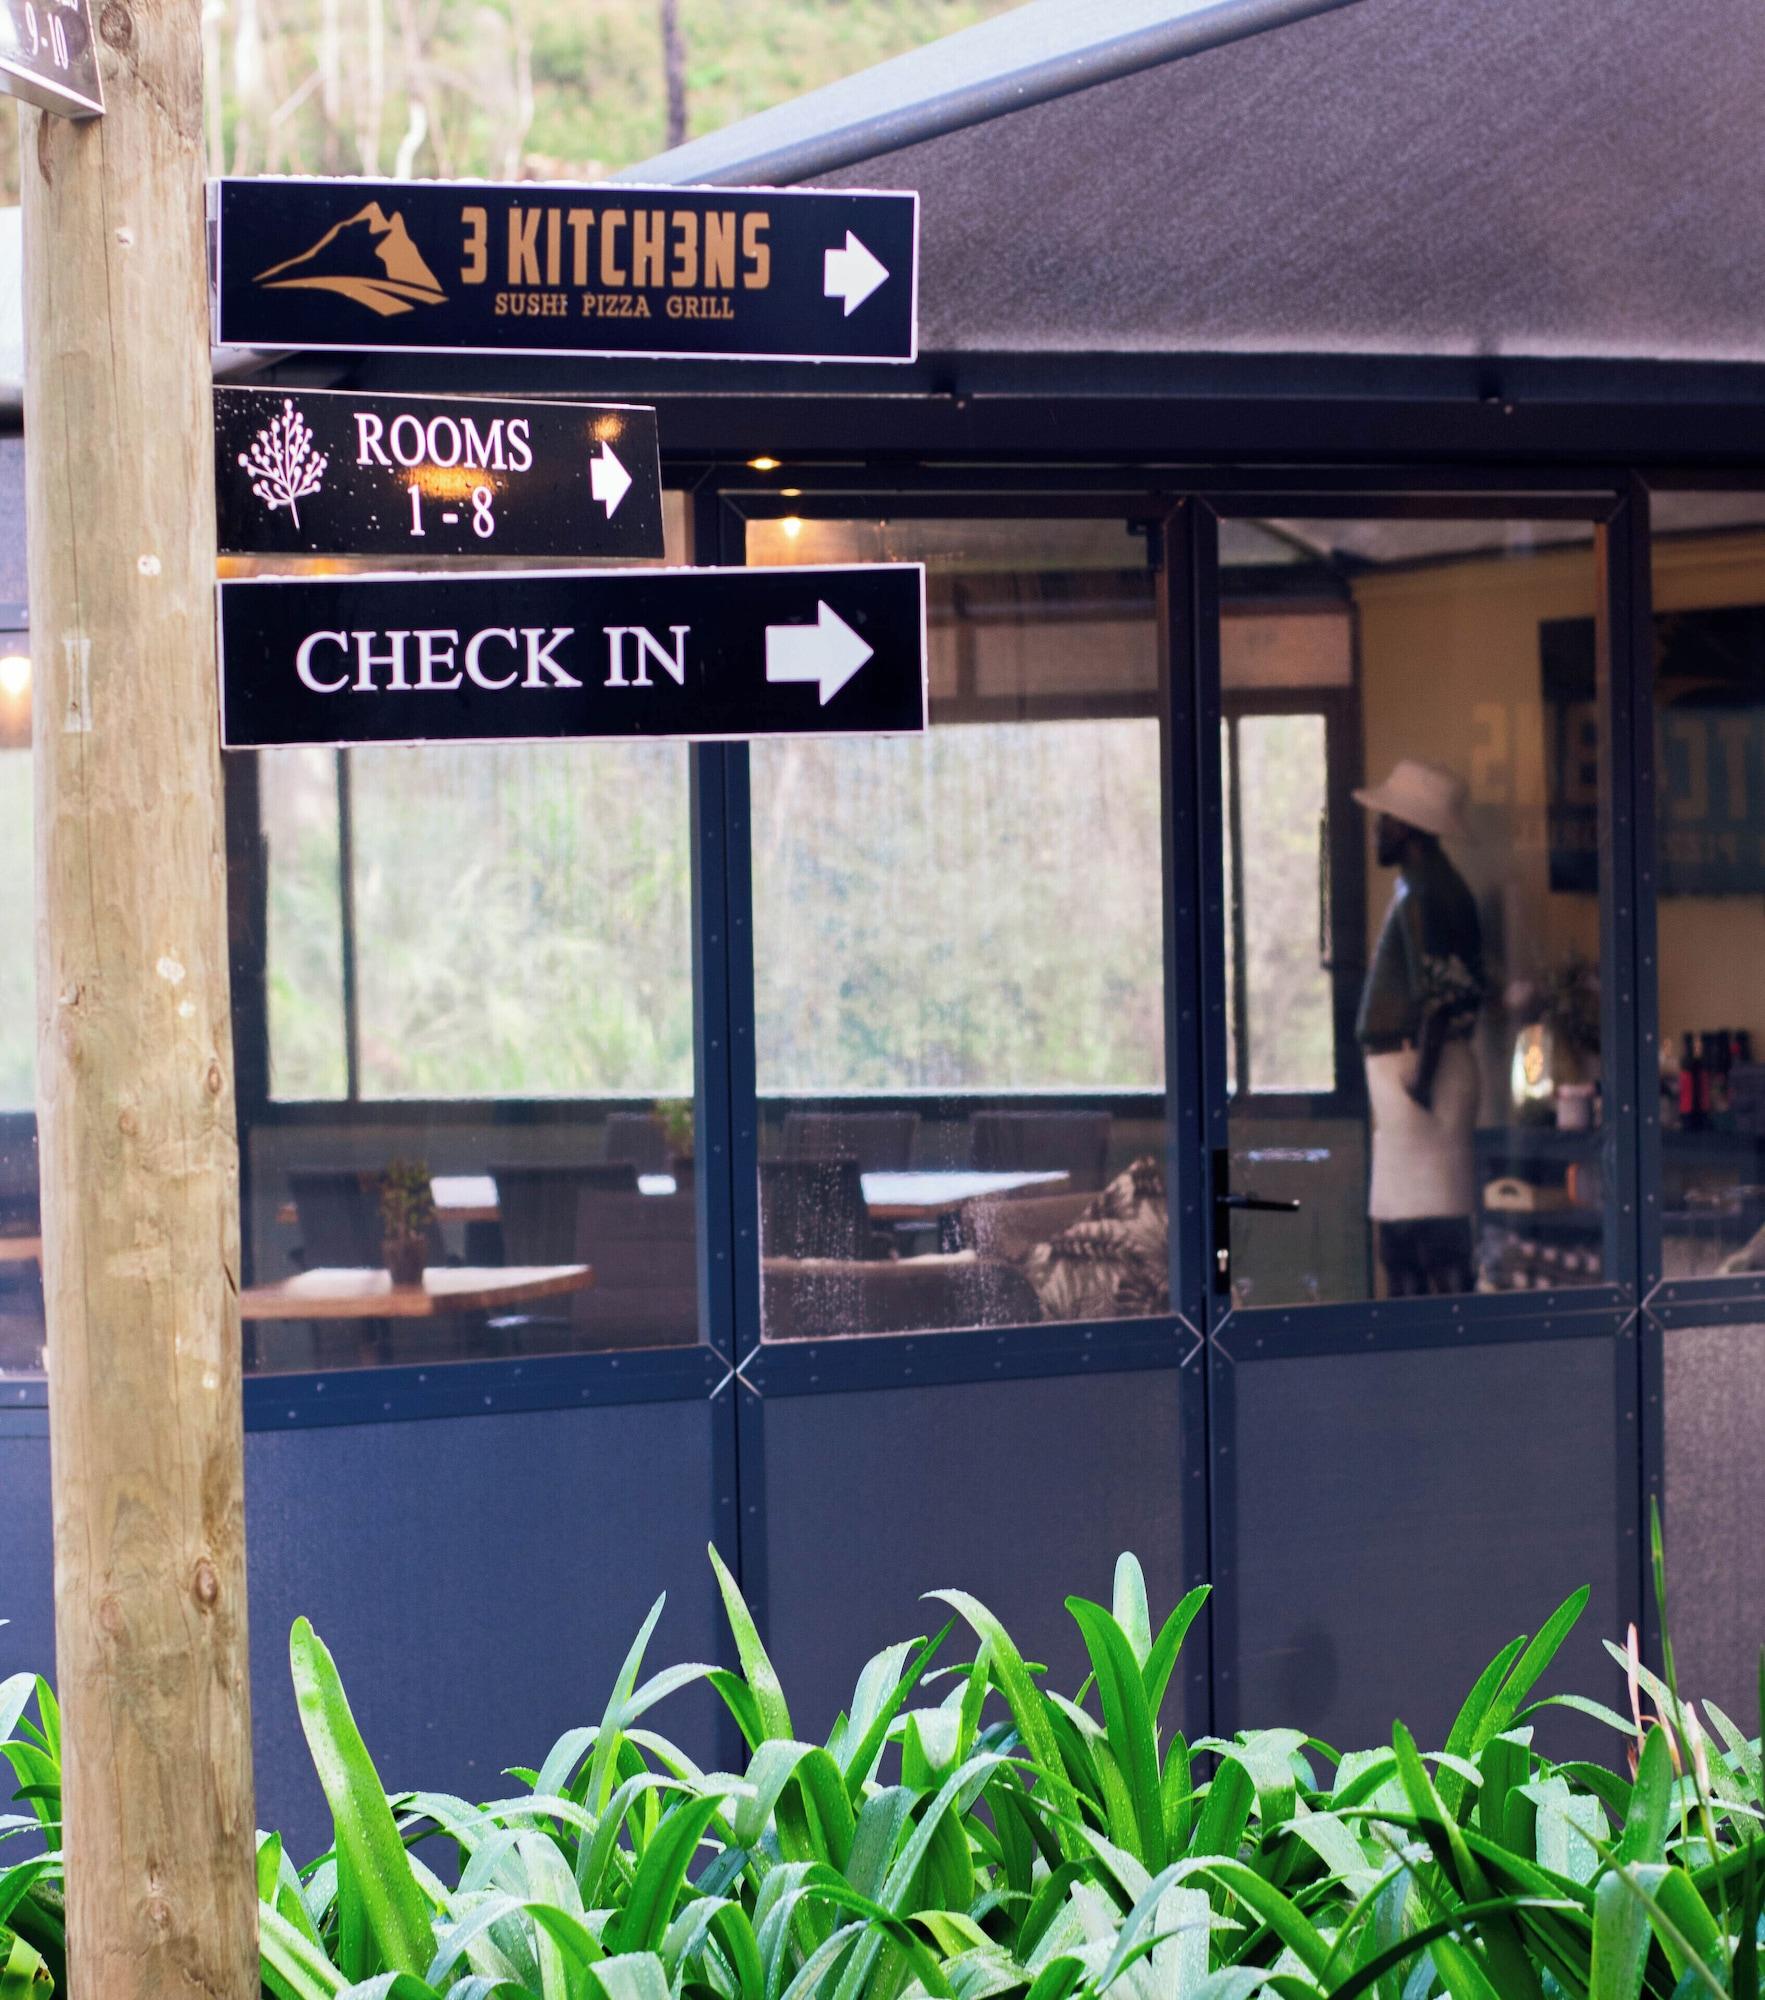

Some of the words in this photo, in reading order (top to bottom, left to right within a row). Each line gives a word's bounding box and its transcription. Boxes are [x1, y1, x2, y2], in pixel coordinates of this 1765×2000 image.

[461, 206, 488, 284] 3
[508, 207, 771, 289] KITCH3NS
[495, 293, 568, 316] SUSHI
[582, 294, 650, 317] PIZZA
[666, 295, 734, 319] GRILL
[353, 412, 533, 472] ROOMS
[296, 627, 583, 693] CHECK
[603, 625, 690, 687] IN
